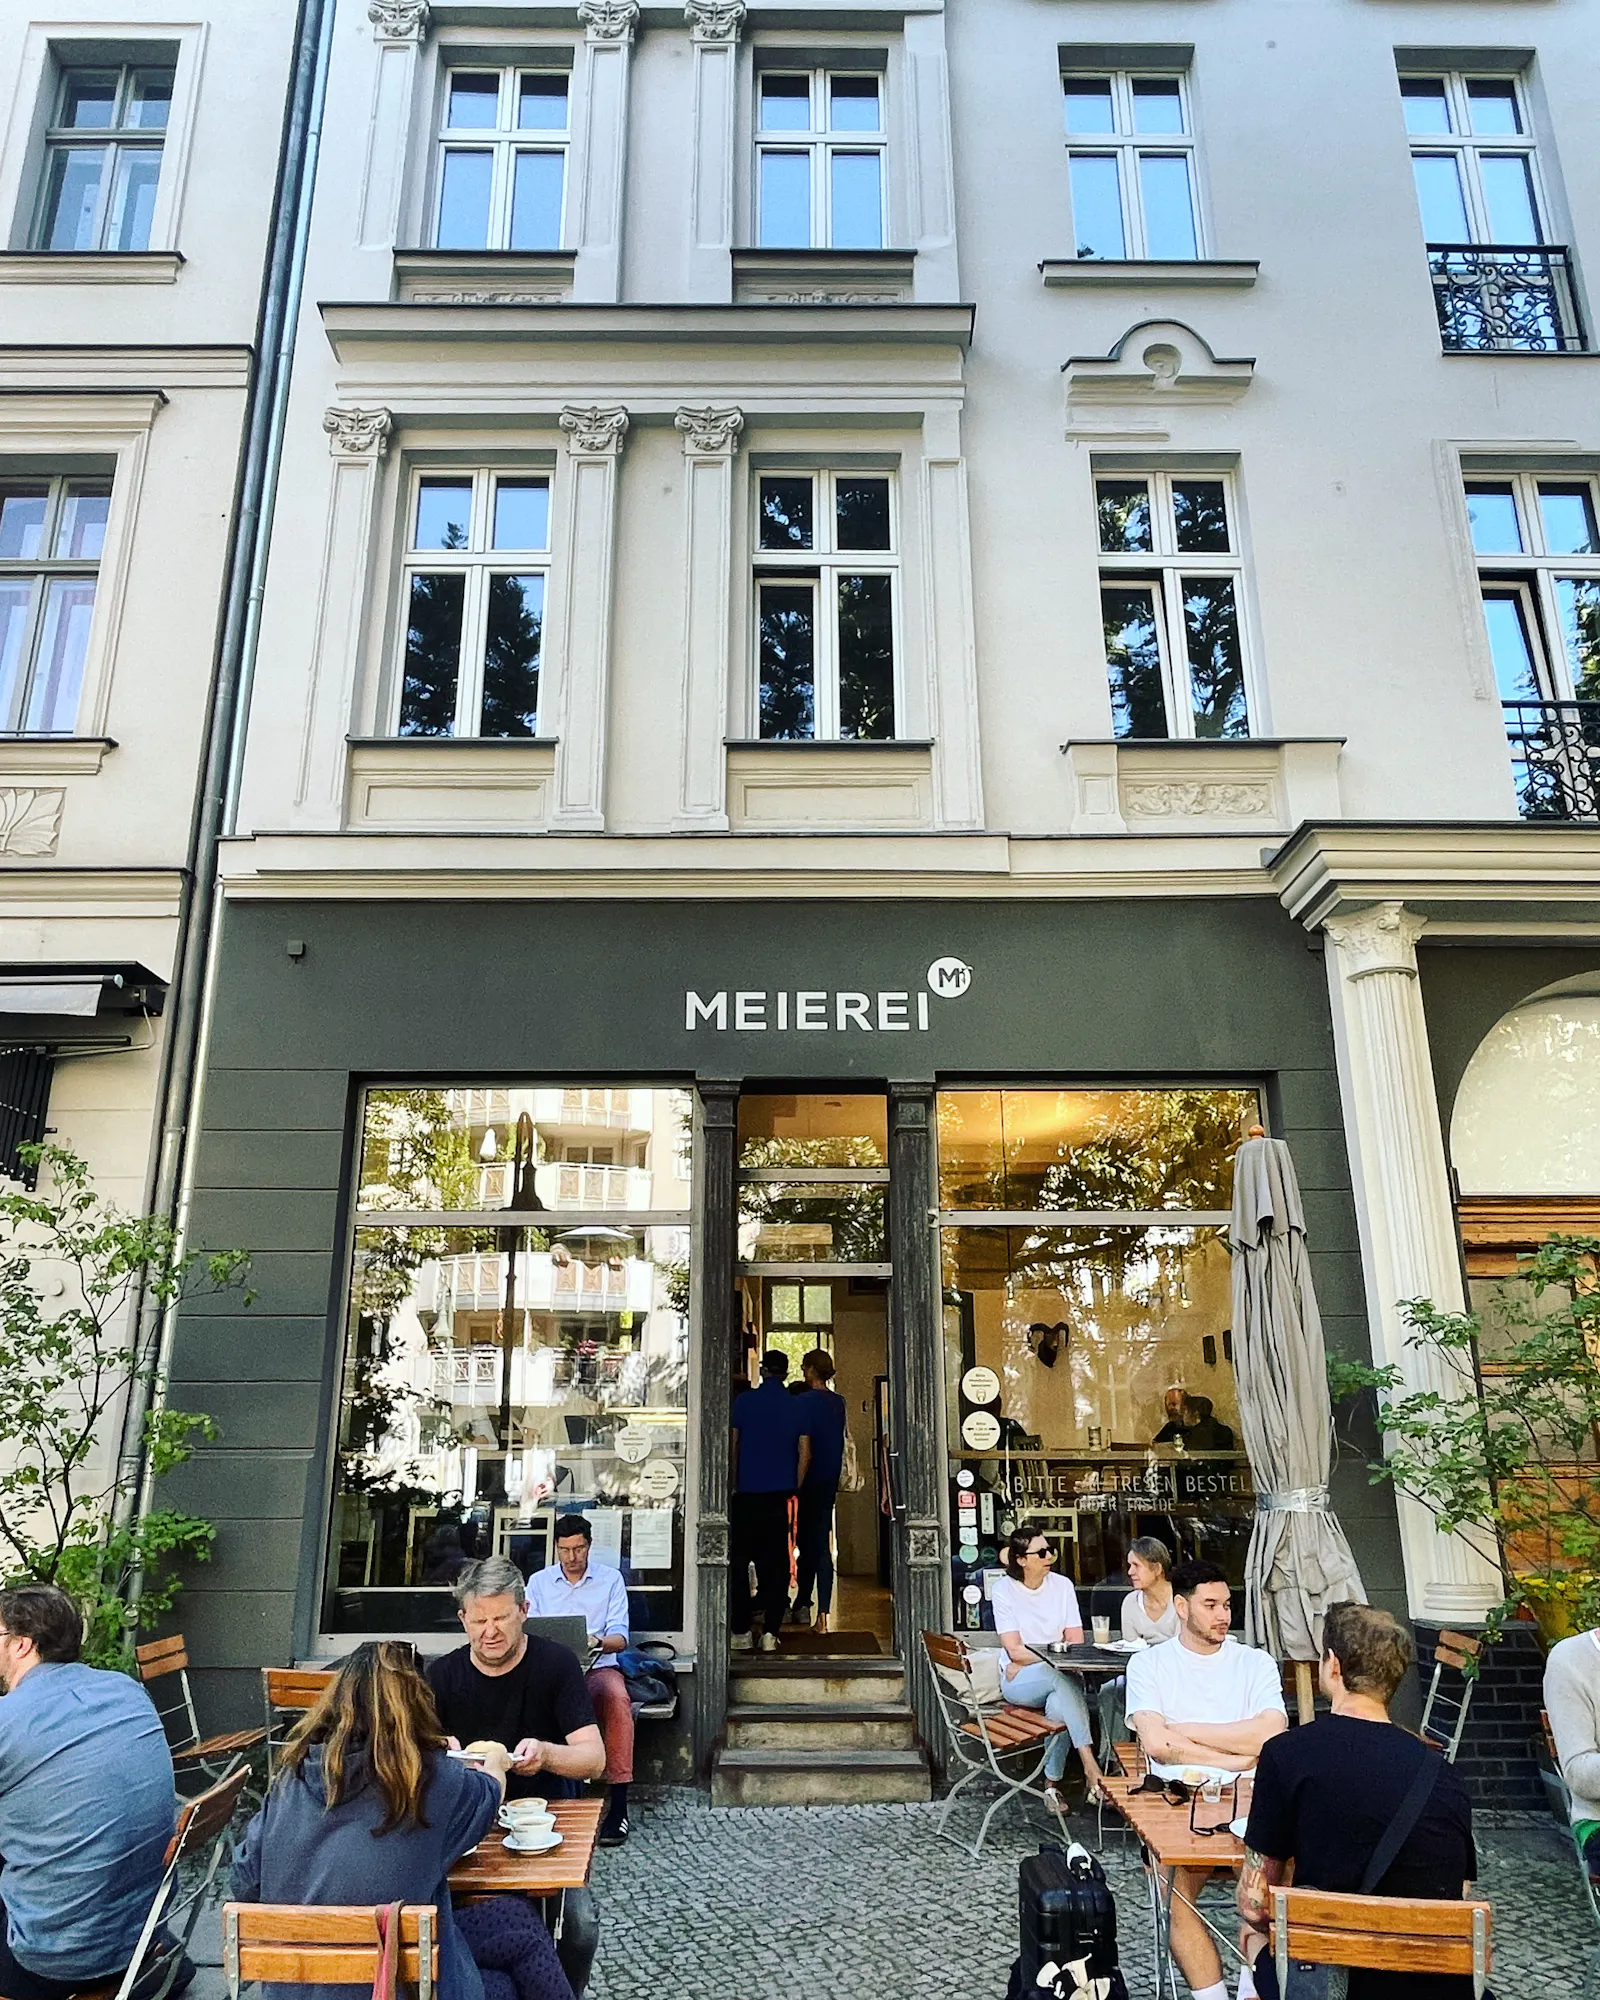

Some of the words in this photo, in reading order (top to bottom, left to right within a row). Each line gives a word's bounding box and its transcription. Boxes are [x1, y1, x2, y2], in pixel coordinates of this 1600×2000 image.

[685, 991, 929, 1031] MEIEREI
[1014, 1476, 1067, 1493] BITTE
[1111, 1475, 1174, 1493] TRESEN
